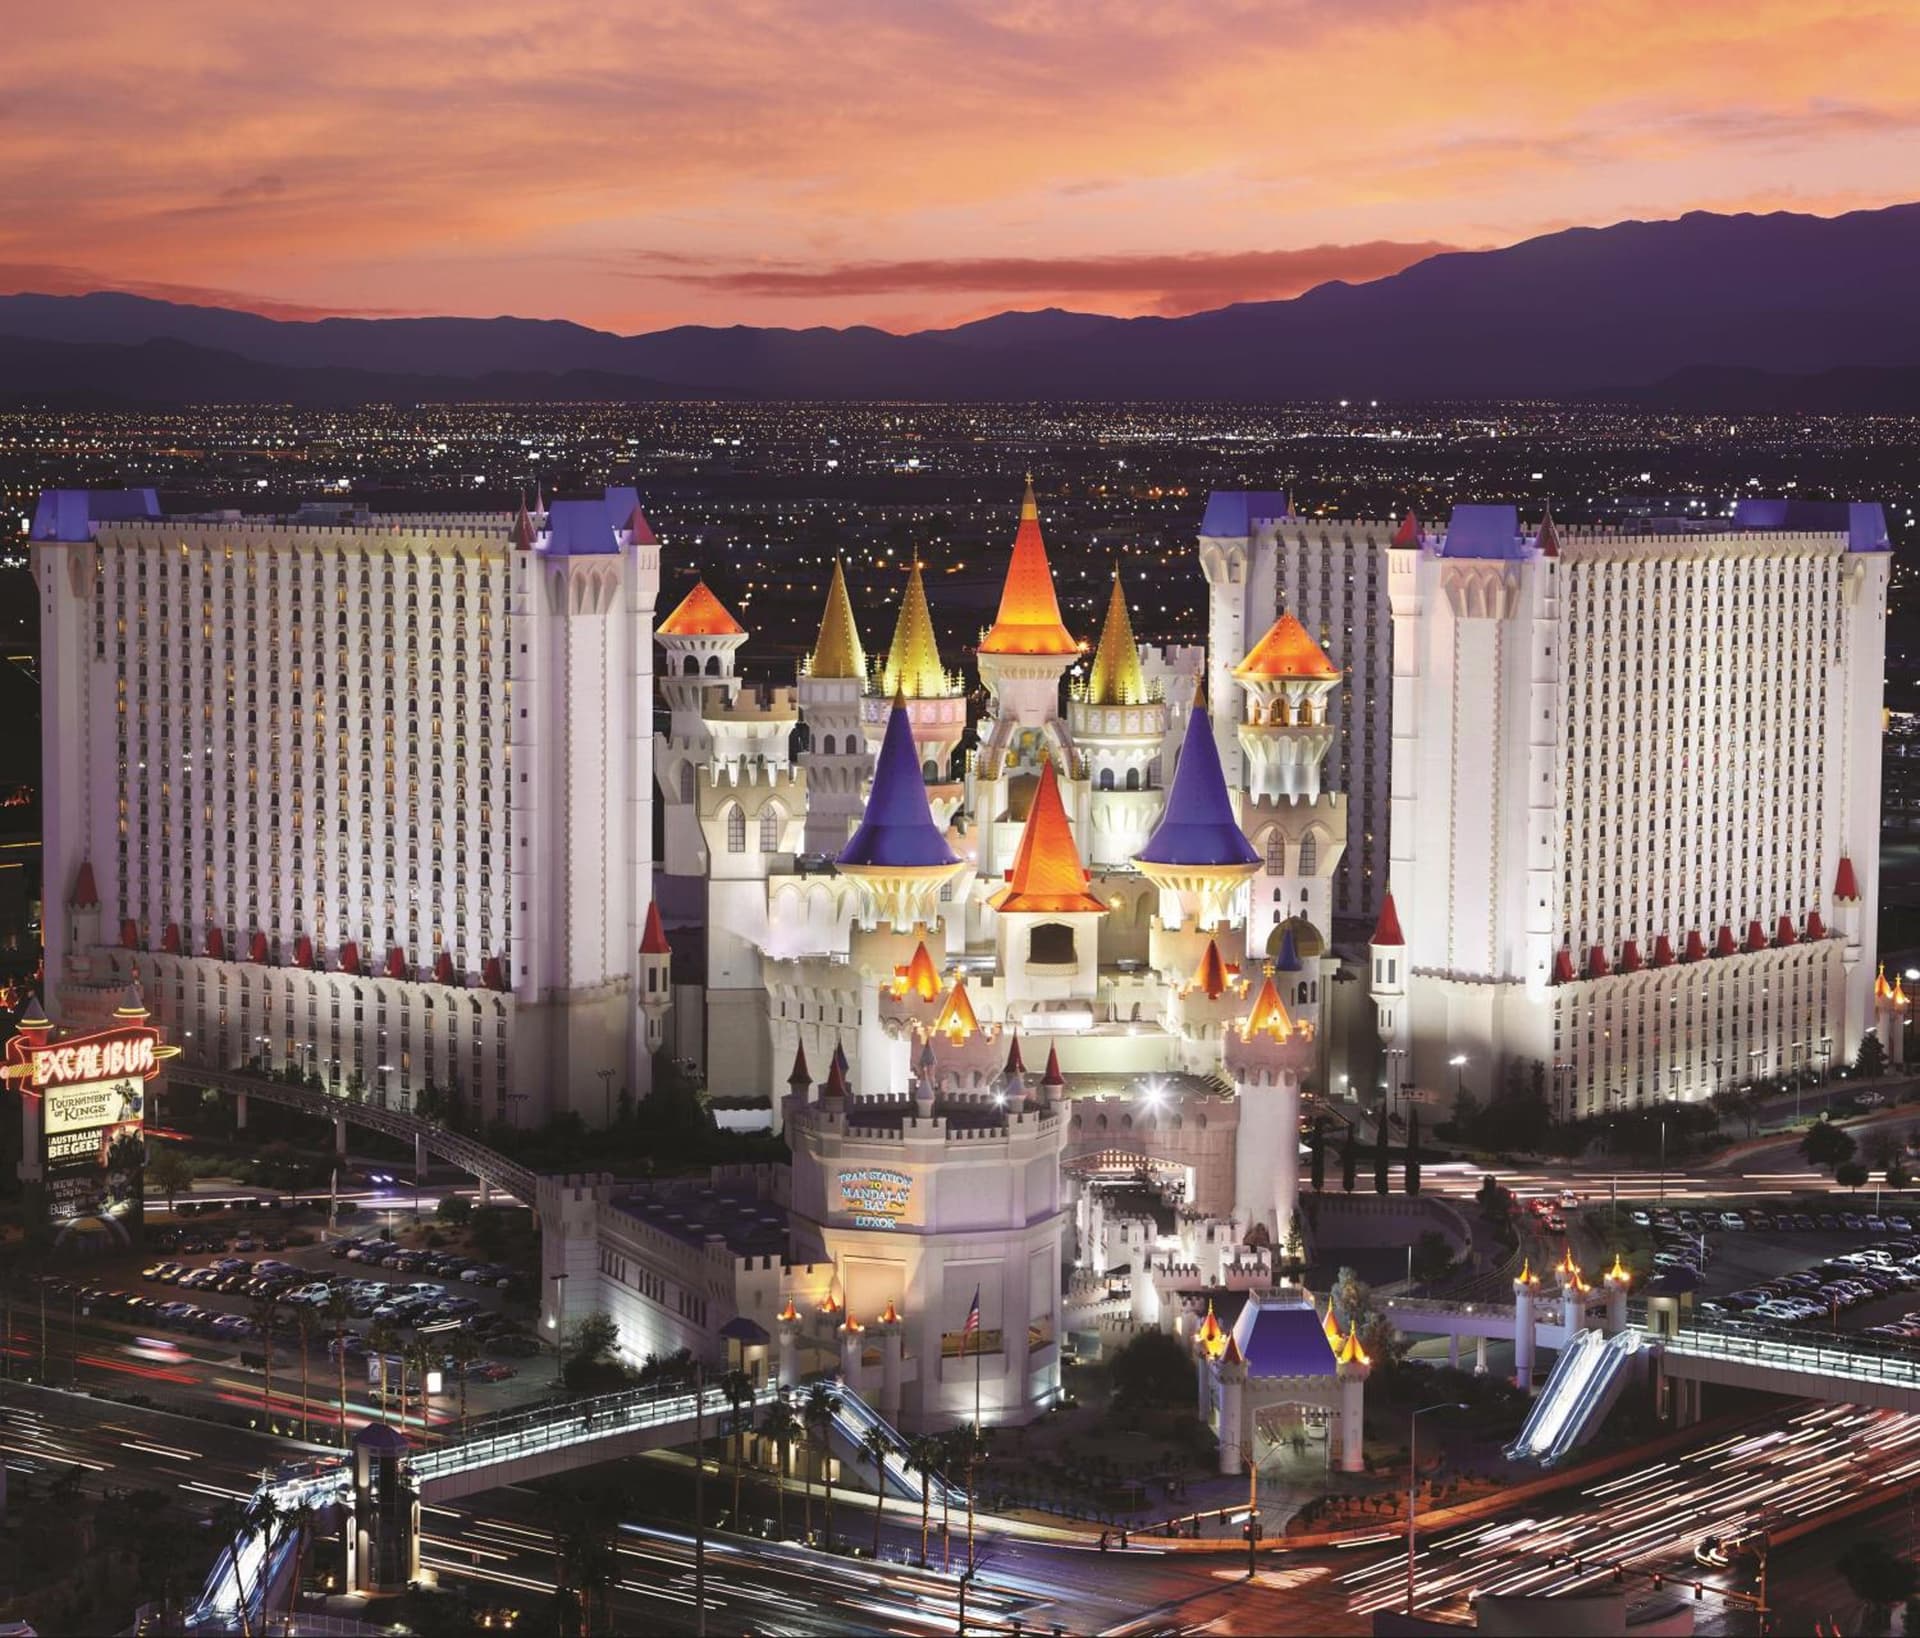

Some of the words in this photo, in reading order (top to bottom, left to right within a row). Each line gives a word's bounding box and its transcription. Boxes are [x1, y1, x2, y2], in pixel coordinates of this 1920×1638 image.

[36, 1037, 155, 1085] EXCALIBUR
[49, 1093, 112, 1112] TOURNAMENT
[63, 1104, 107, 1121] KINGS
[52, 1129, 103, 1145] AUSTRALIAN
[838, 1170, 867, 1183] TRAM
[869, 1170, 913, 1187] STATION
[870, 1181, 882, 1190] TO
[842, 1187, 907, 1202] MANDALAY
[864, 1200, 887, 1212] BAY
[855, 1216, 896, 1229] LUXOR
